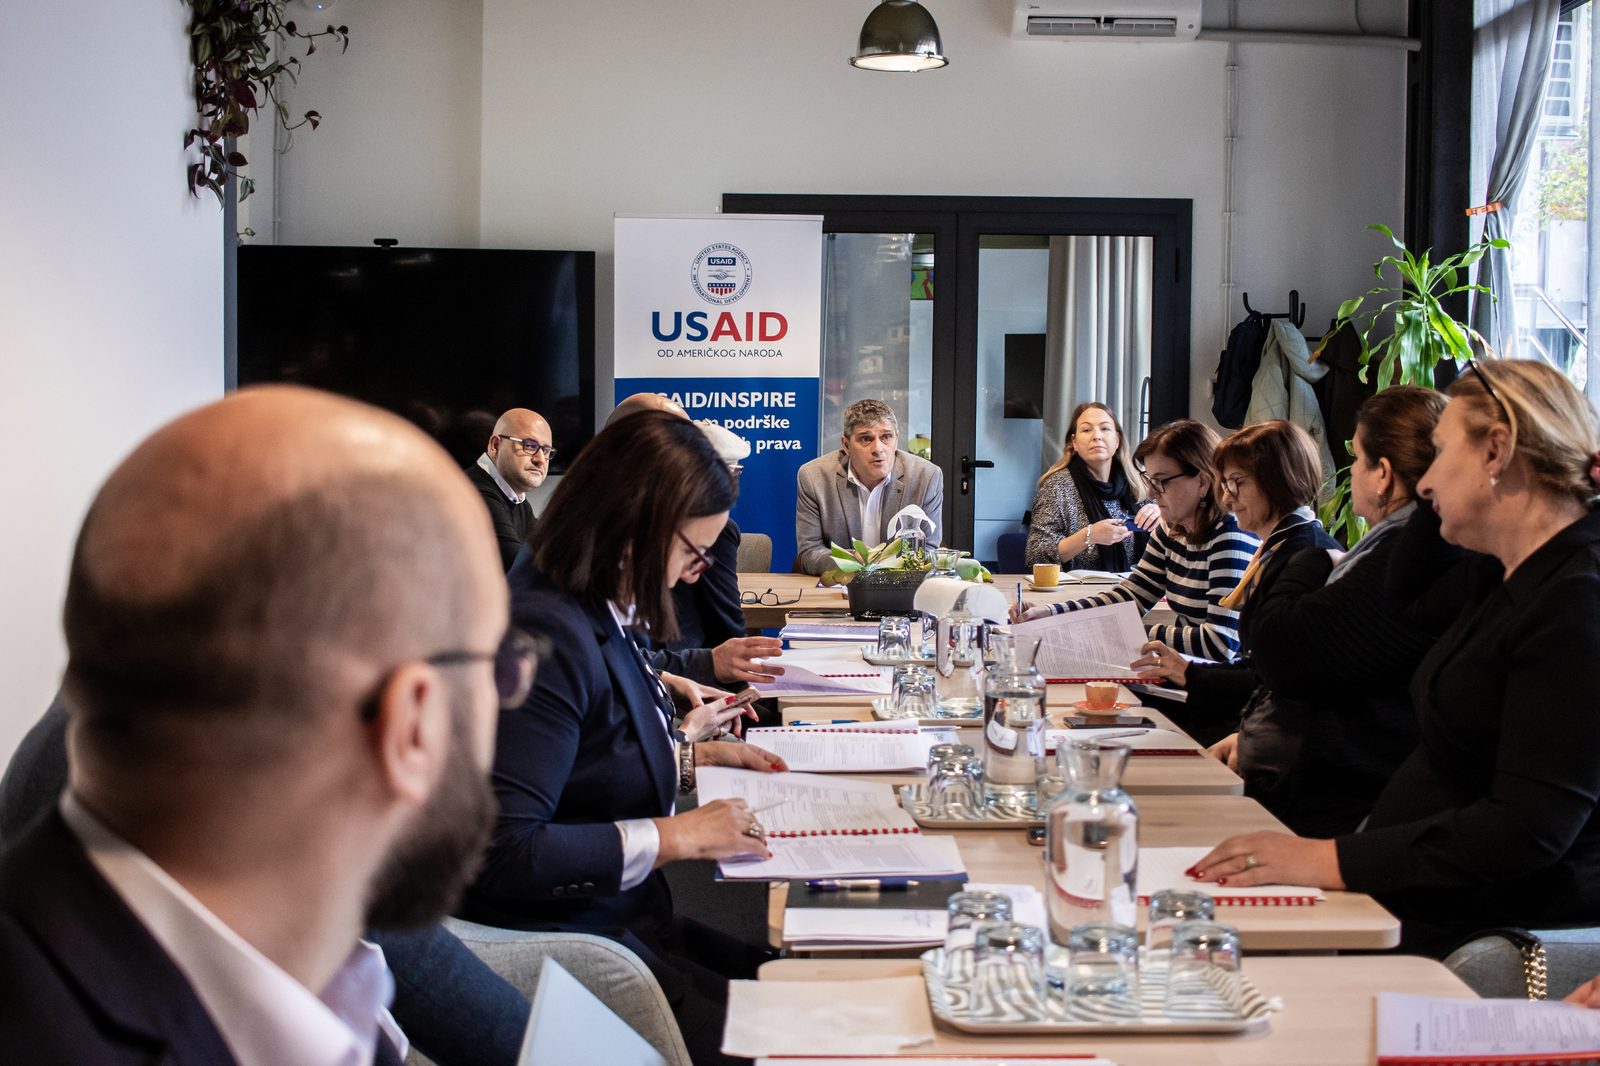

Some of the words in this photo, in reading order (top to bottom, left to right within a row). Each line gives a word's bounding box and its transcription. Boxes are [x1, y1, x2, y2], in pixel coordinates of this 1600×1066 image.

[695, 247, 711, 264] UNITED
[731, 247, 749, 264] AGENCY
[692, 274, 723, 304] INTERNATIONAL
[724, 274, 751, 304] DEVELOPMENT
[651, 311, 789, 342] USAID
[657, 349, 674, 358] OD
[677, 347, 736, 358] AMERIČKOG
[739, 349, 783, 358] NARODA
[656, 391, 796, 408] AID/INSPIRE
[724, 414, 790, 430] podrške
[756, 439, 802, 454] prava
